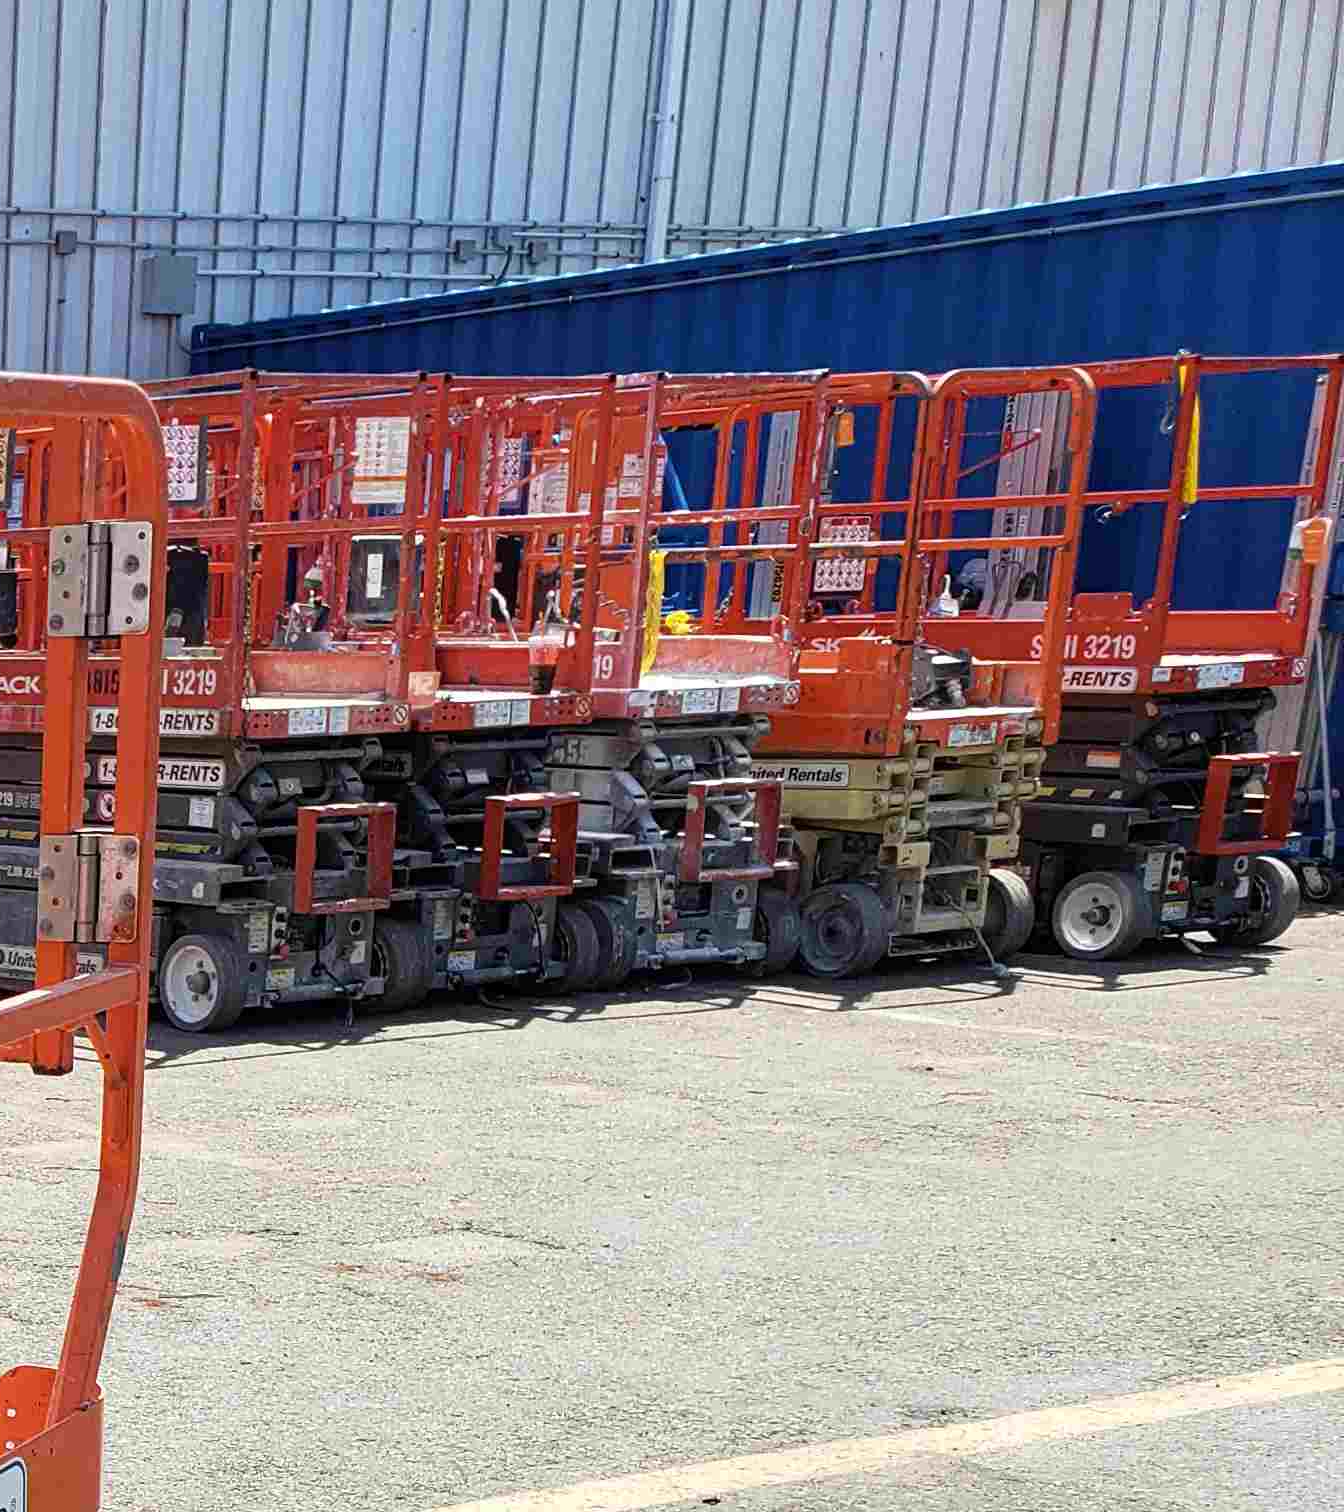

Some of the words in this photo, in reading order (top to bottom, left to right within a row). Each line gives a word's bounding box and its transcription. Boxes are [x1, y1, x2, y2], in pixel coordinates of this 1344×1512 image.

[1083, 635, 1136, 659] 3219
[173, 669, 217, 695] 3219
[1064, 671, 1133, 687] -RENTS
[787, 766, 843, 783] Rentals
